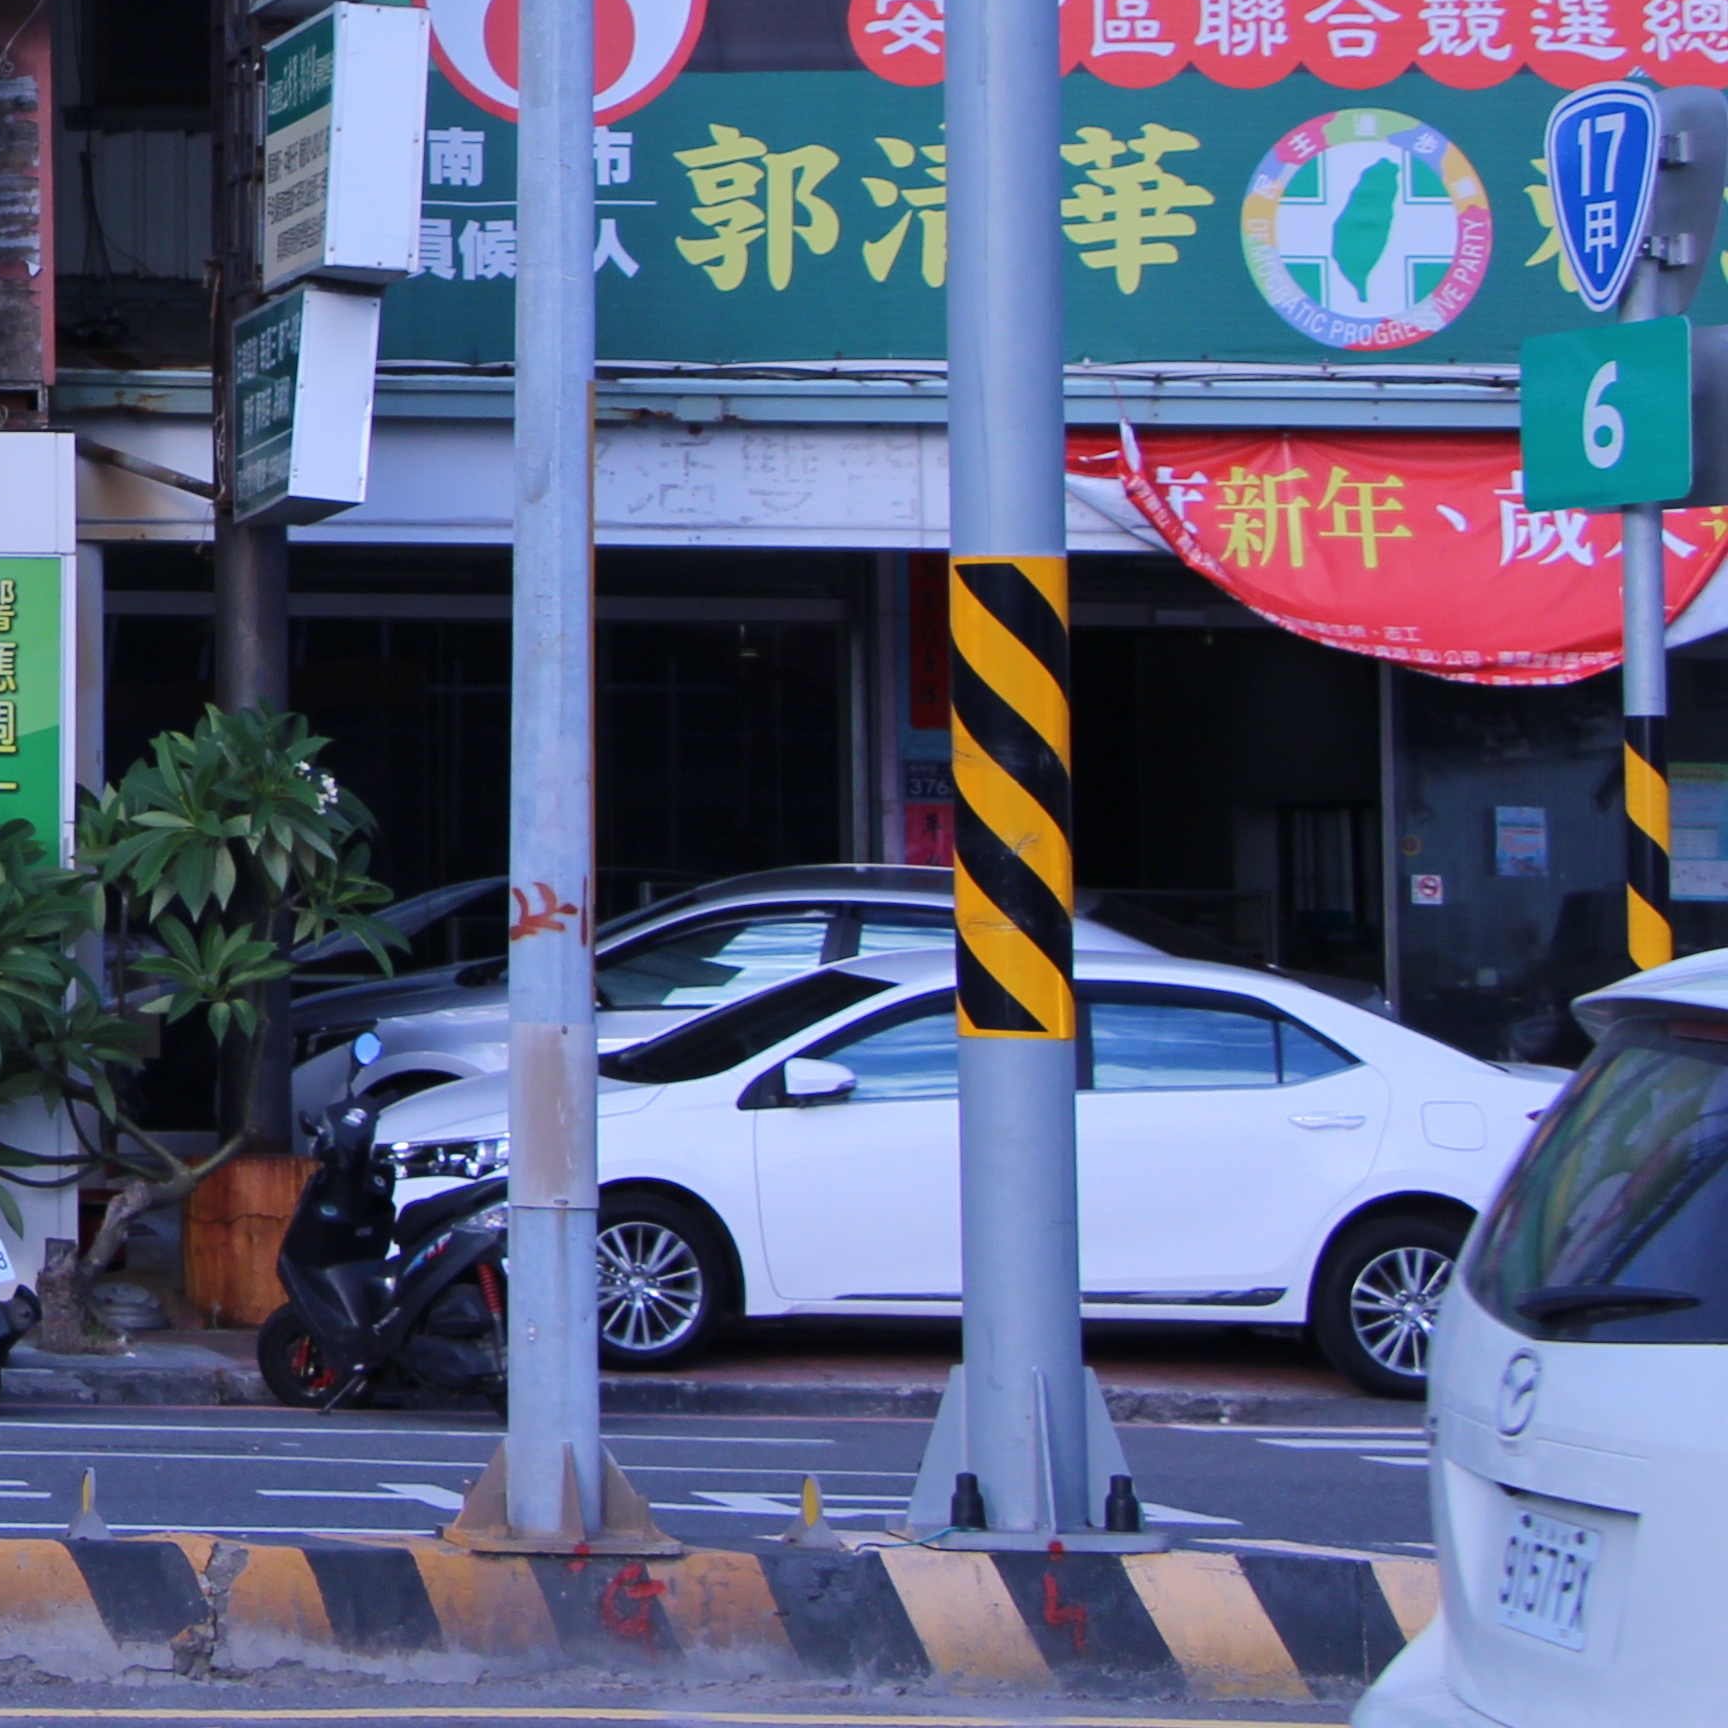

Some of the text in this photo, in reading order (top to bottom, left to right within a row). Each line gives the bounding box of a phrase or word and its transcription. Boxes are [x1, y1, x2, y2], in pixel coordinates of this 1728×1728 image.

[1577, 112, 1626, 198] 17
[1250, 218, 1326, 333] DEMOCRATIC
[1459, 218, 1485, 284] PARTY
[1584, 200, 1617, 274] 甲
[1582, 360, 1625, 470] 6
